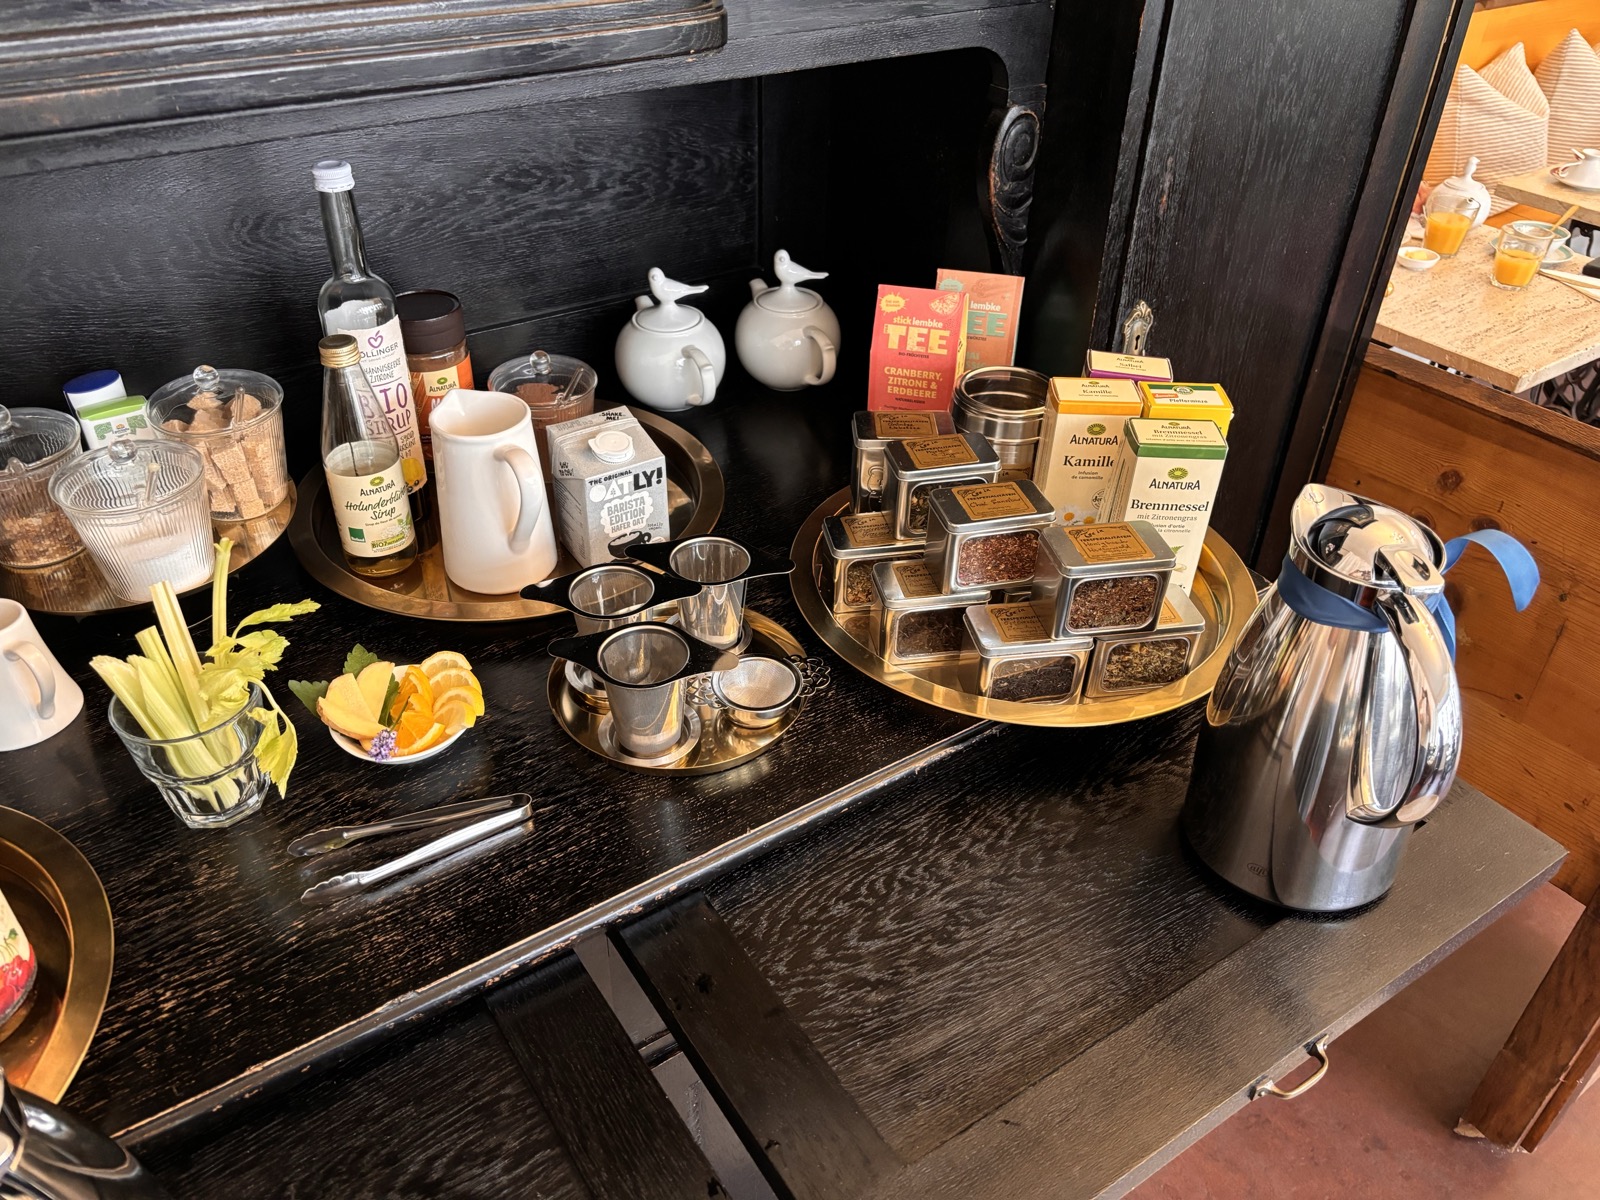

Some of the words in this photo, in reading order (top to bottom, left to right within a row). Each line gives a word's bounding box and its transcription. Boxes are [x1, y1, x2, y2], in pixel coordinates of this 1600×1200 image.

[970, 301, 1001, 311] lembke
[893, 315, 911, 325] stick
[912, 317, 943, 328] lembke
[968, 310, 1008, 337] EE
[884, 324, 950, 355] TEE
[360, 342, 399, 359] OLLINGER
[368, 371, 395, 384] ZITRONE
[884, 366, 943, 381] CRANBERRY,
[429, 381, 457, 393] ALNATURA
[887, 376, 928, 389] ZITRONE
[930, 381, 938, 389] &
[887, 385, 937, 399] ERDBEERE
[1069, 434, 1118, 446] ALNATURA
[588, 478, 603, 486] THE
[603, 470, 632, 482] ORIGINAL
[589, 467, 663, 503] OATLY!
[1149, 478, 1201, 491] ALNATURA
[360, 479, 396, 497] ALNATURA
[607, 496, 646, 516] BARISTA
[1130, 498, 1210, 512] Brennnessel
[370, 506, 396, 520] Sirup
[609, 506, 646, 526] EDITION
[1151, 513, 1198, 523] Zitronengras
[611, 521, 631, 534] HAFER
[632, 517, 645, 527] OAT
